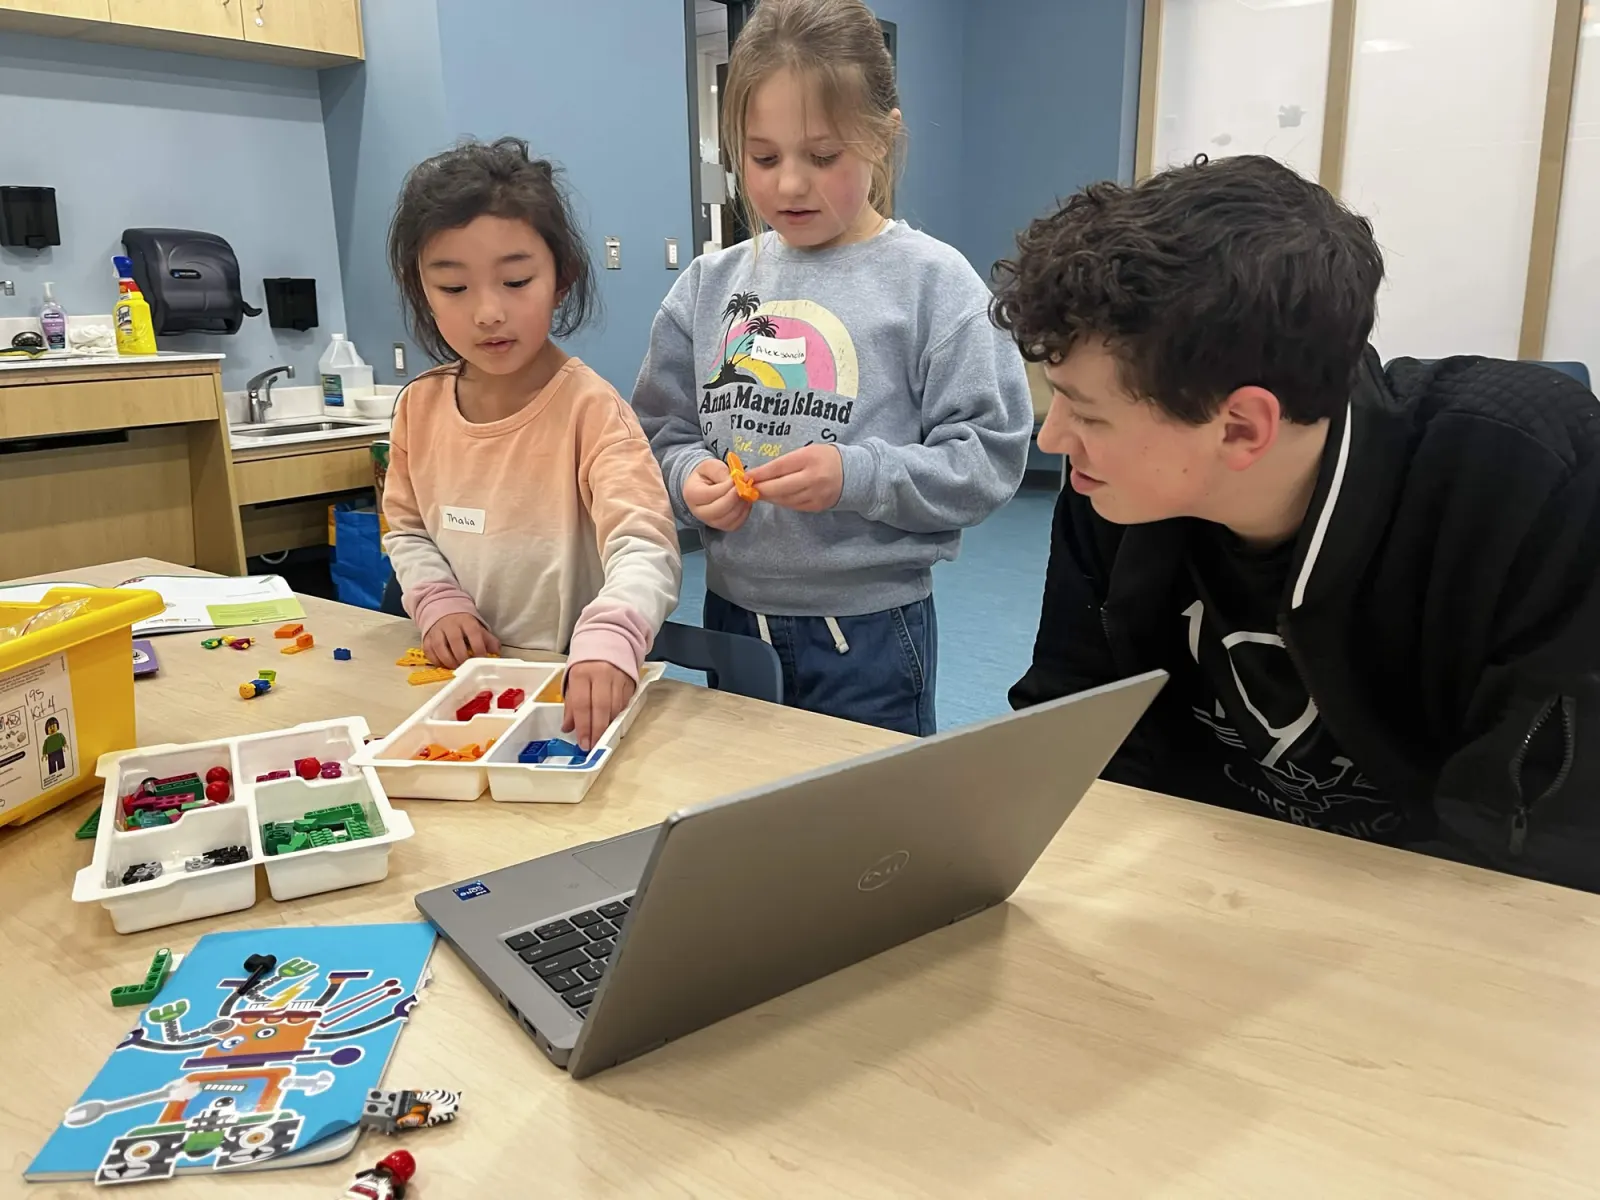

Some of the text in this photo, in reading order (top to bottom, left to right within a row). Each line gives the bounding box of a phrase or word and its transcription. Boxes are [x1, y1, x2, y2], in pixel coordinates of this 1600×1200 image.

[699, 385, 853, 424] Anna Maria Island
[730, 414, 791, 436] Florida
[446, 512, 475, 526] Thalia
